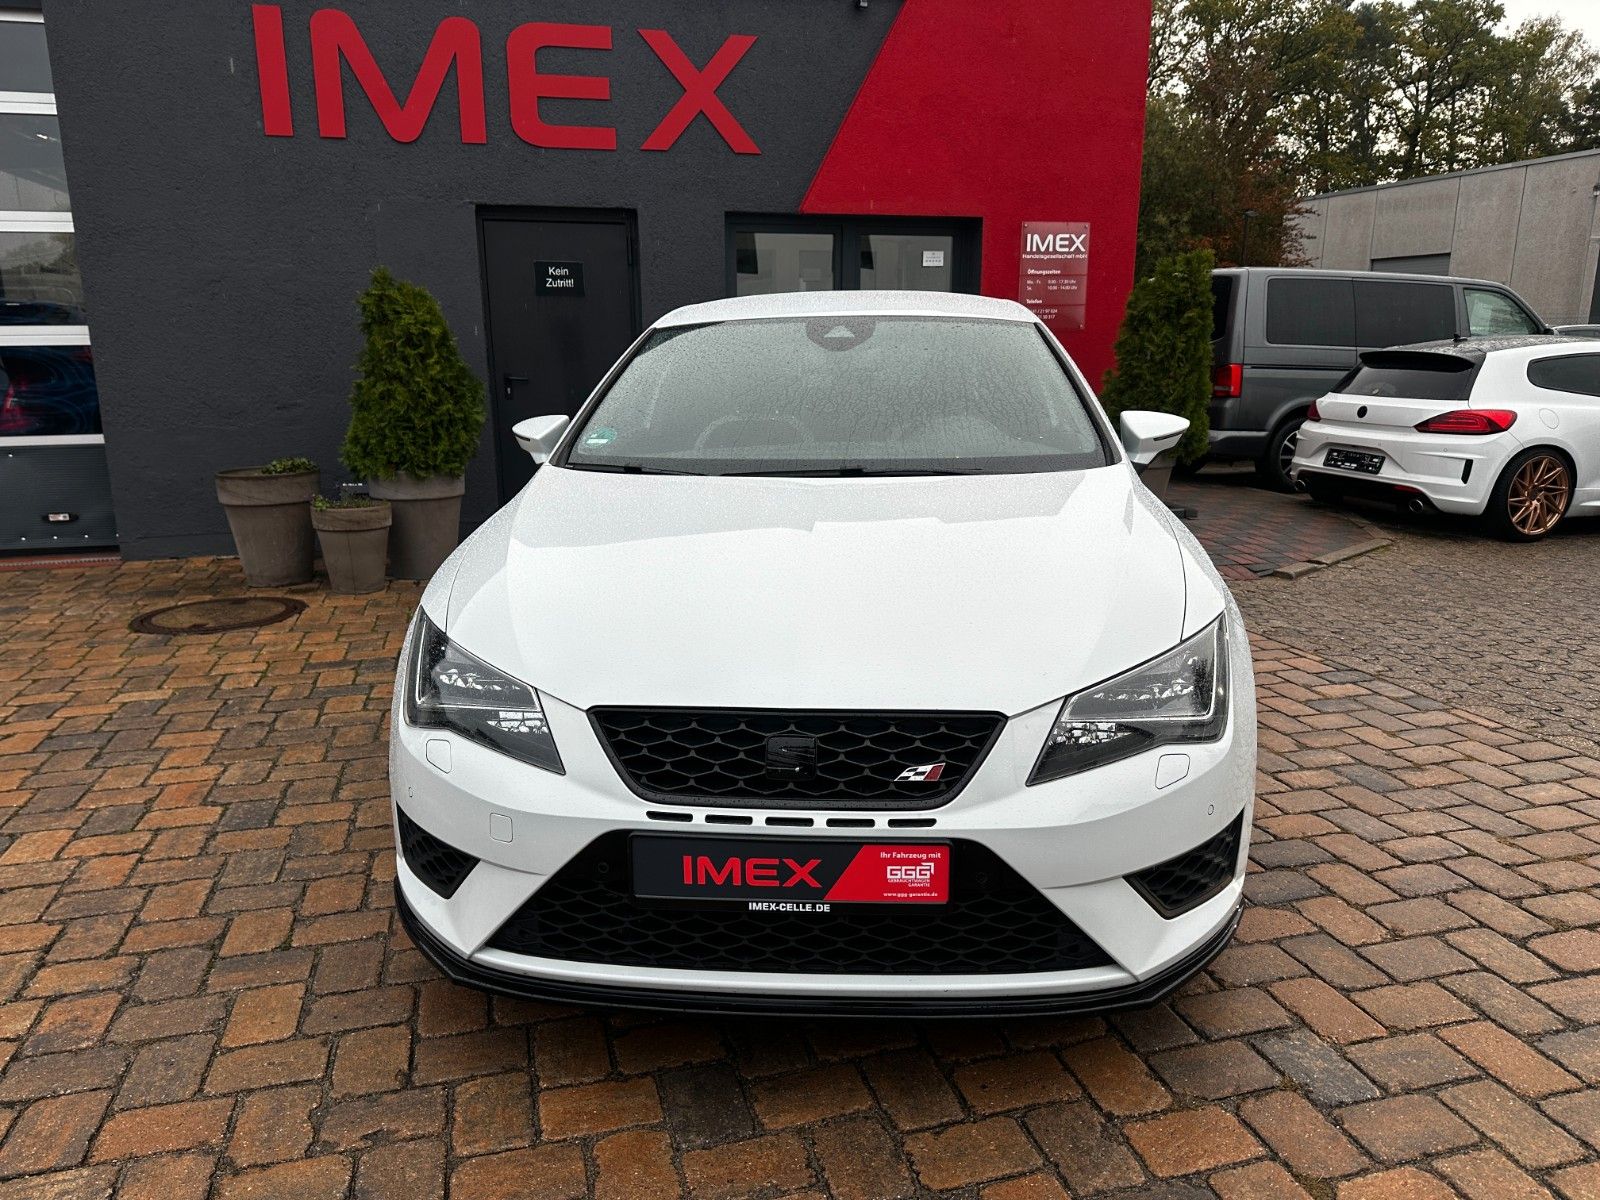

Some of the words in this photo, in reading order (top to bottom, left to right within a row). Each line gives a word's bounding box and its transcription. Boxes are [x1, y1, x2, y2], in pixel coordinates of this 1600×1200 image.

[252, 4, 762, 155] IMEX
[1026, 233, 1087, 252] IMEX
[548, 266, 569, 276] Kein
[545, 278, 575, 288] Zutritt!
[892, 852, 927, 860] Fahrzeug
[928, 851, 941, 859] mit
[683, 855, 822, 888] IMEX
[886, 865, 931, 879] GGG
[748, 902, 831, 913] IMEX-CELLE.DE
